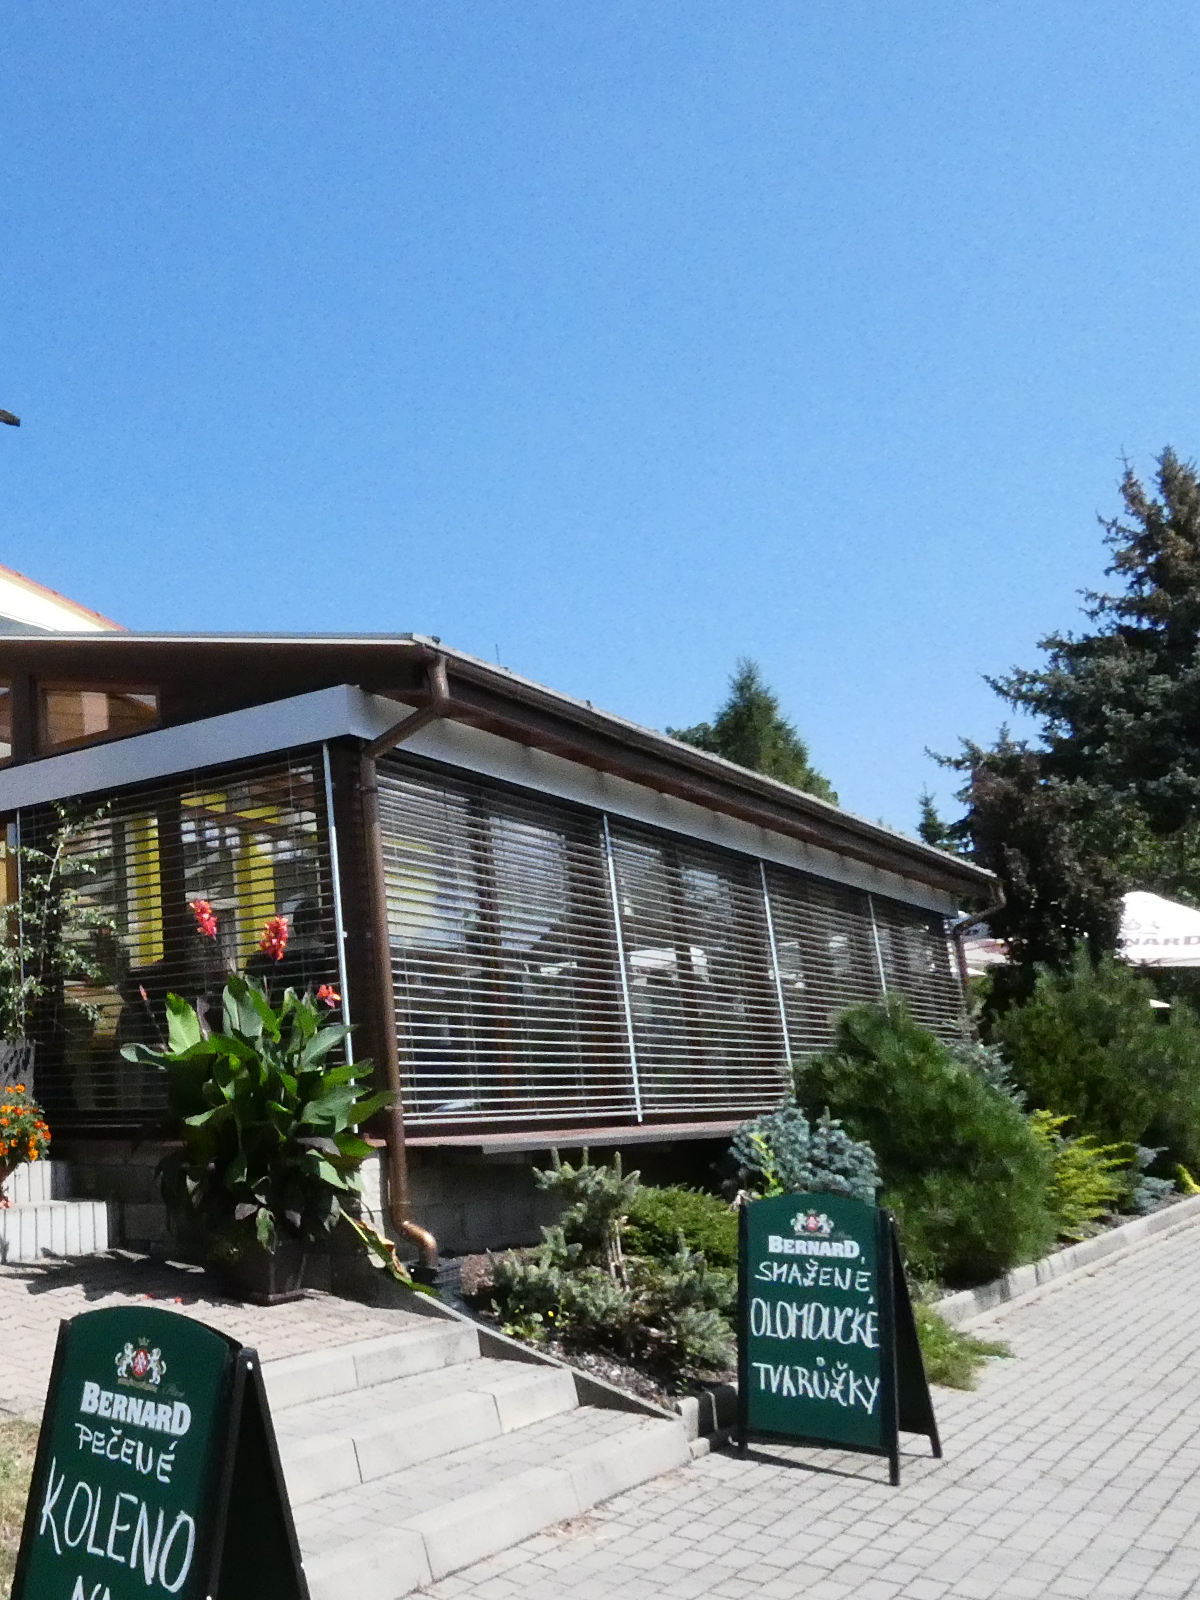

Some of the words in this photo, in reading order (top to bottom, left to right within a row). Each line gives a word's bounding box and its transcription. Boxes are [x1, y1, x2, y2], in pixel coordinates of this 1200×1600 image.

[1124, 935, 1200, 946] NARD
[768, 1236, 860, 1258] BERNARD
[80, 1380, 192, 1436] BERNARD
[751, 1357, 880, 1415] TVARŮŽKY
[75, 1422, 176, 1484] PEČENÉ
[39, 1456, 196, 1593] KOLENO
